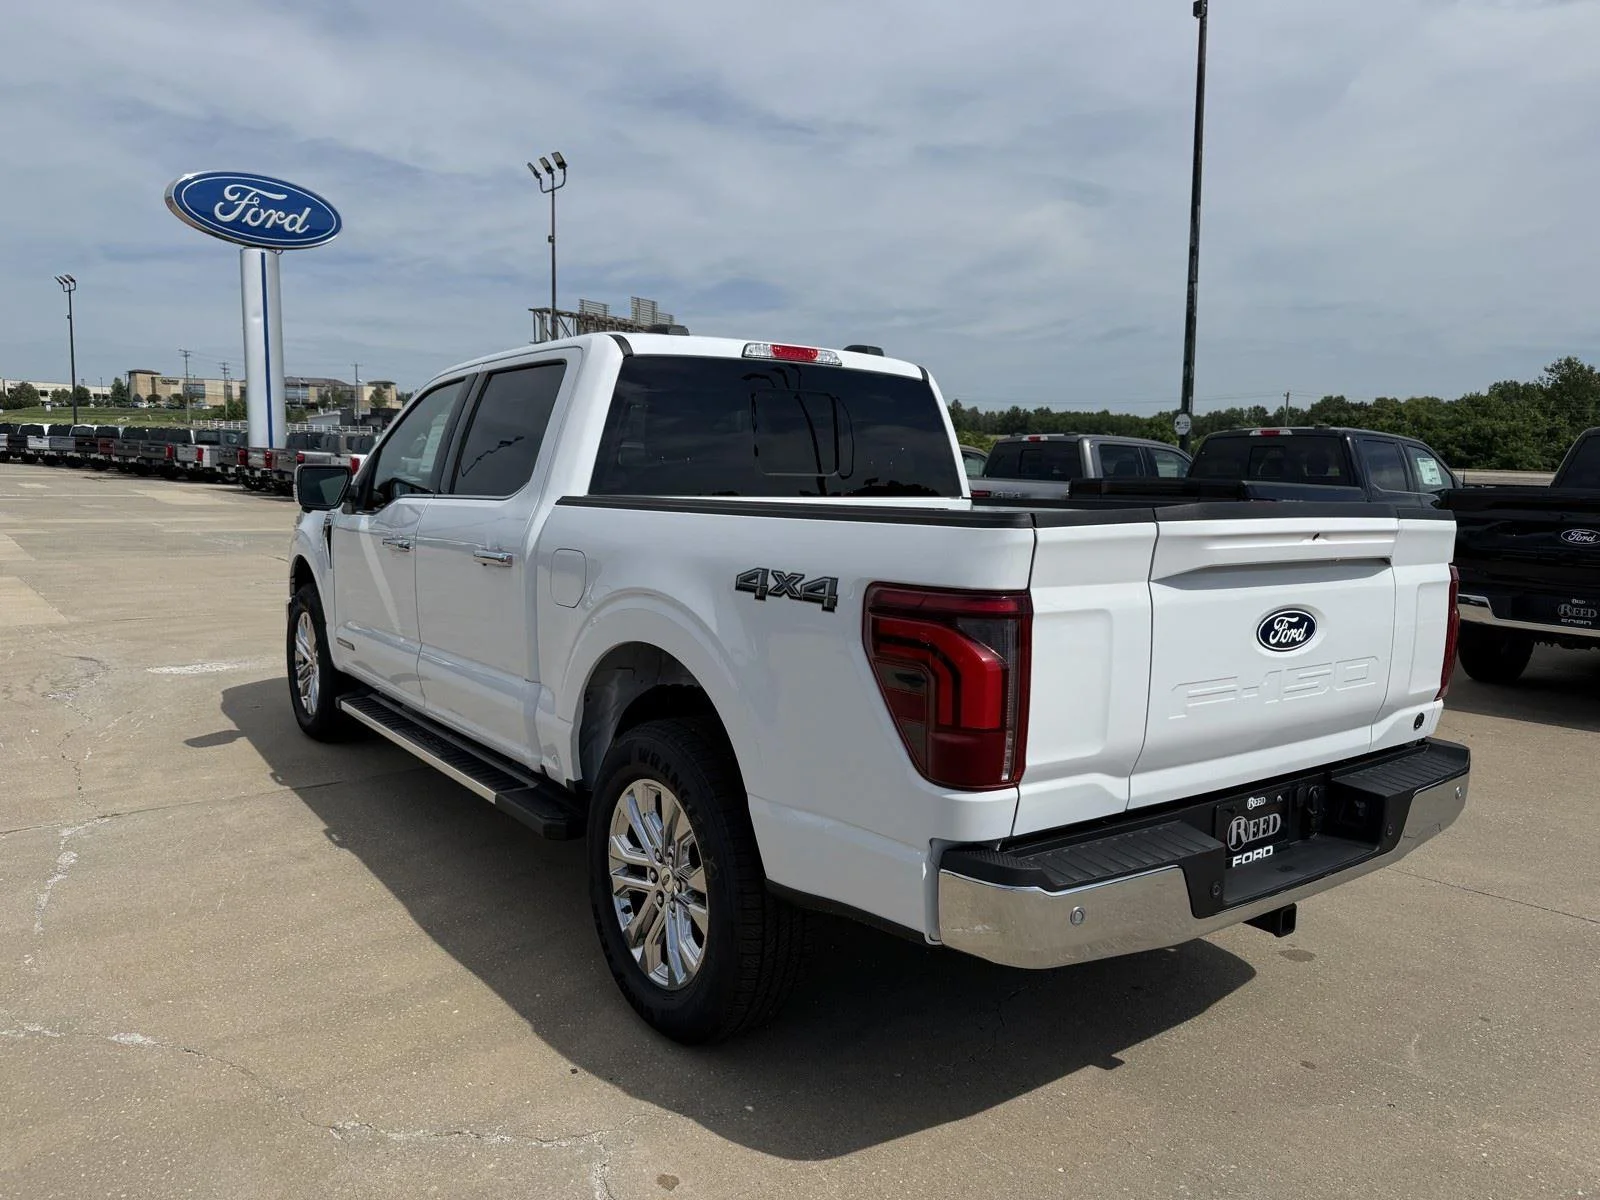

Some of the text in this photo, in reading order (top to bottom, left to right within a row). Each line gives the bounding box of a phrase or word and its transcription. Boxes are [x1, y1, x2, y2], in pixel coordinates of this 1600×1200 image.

[214, 184, 311, 234] Ford
[1568, 529, 1596, 542] Ford
[1268, 616, 1308, 645] Ford
[1168, 655, 1379, 720] F-150
[1227, 813, 1282, 851] REED
[1232, 845, 1274, 868] FORD
